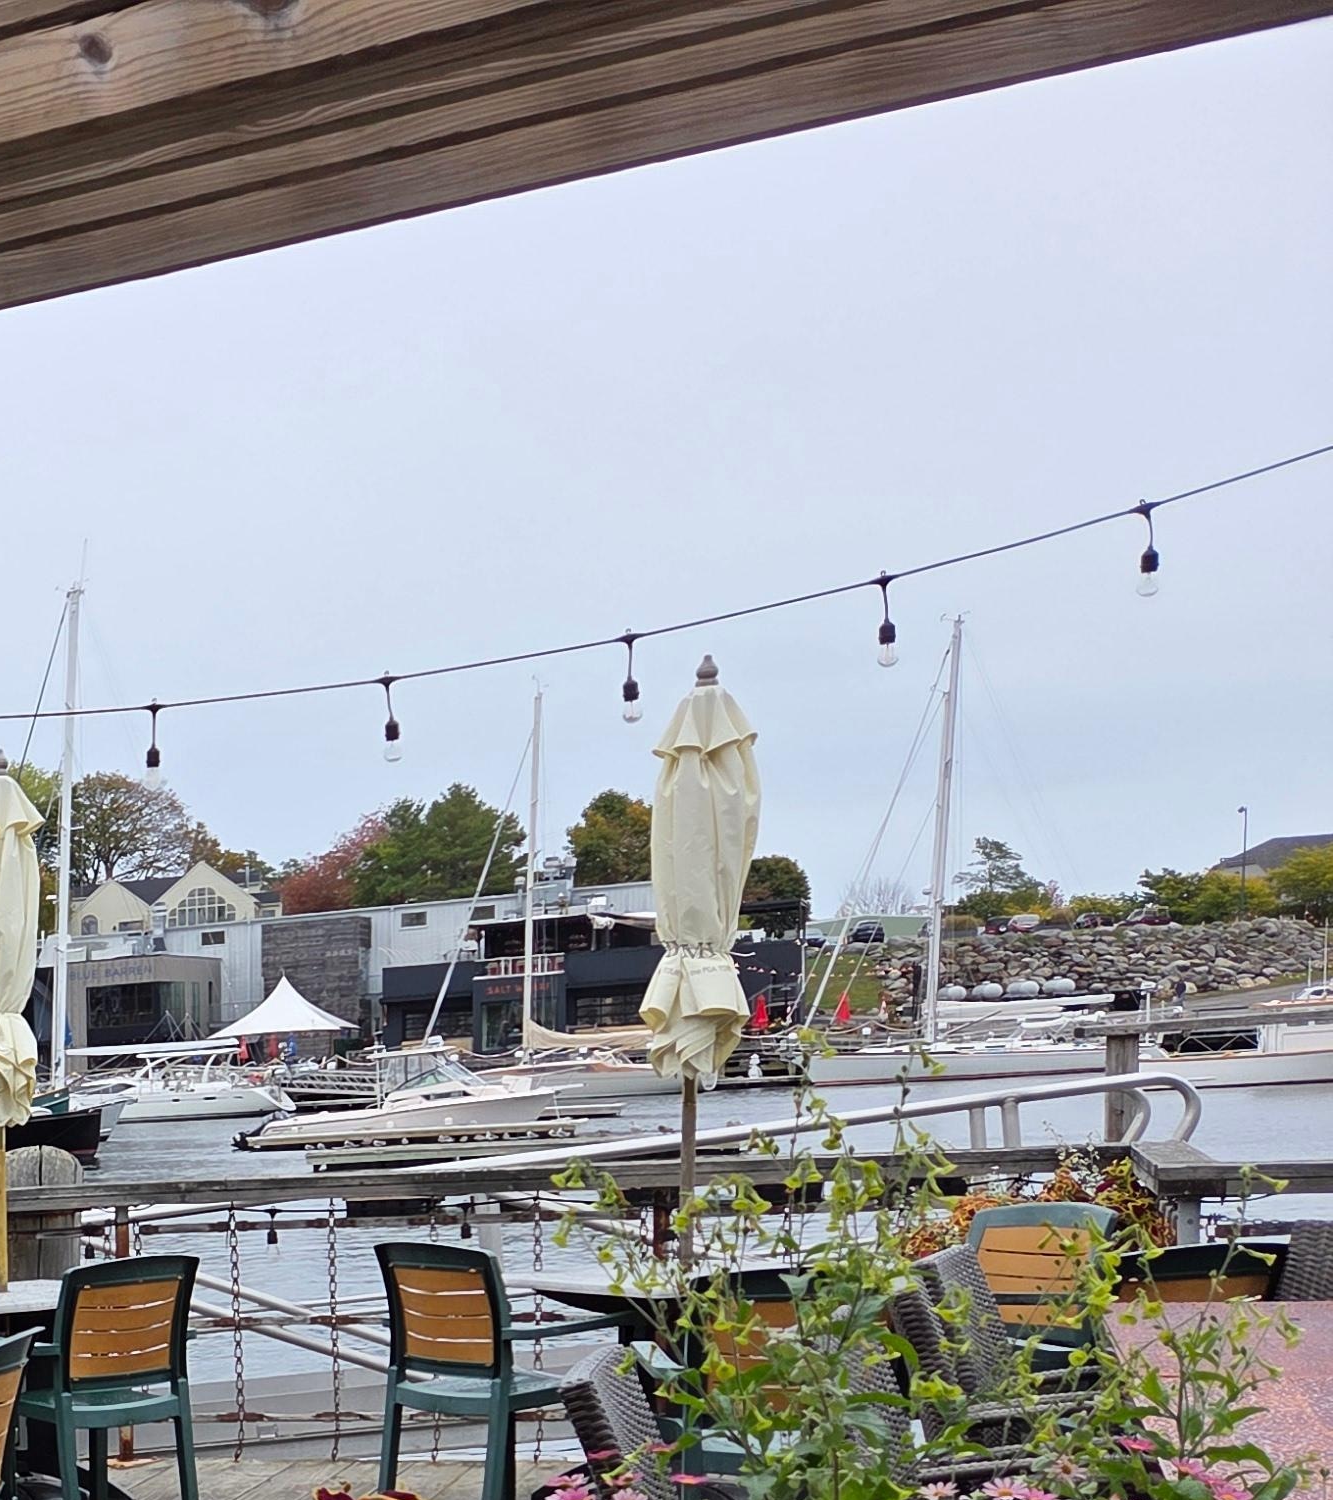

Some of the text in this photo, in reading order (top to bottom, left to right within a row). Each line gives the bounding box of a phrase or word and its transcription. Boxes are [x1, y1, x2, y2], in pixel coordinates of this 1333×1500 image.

[69, 966, 152, 980] BLUE BARREN
[485, 985, 511, 995] SALT
